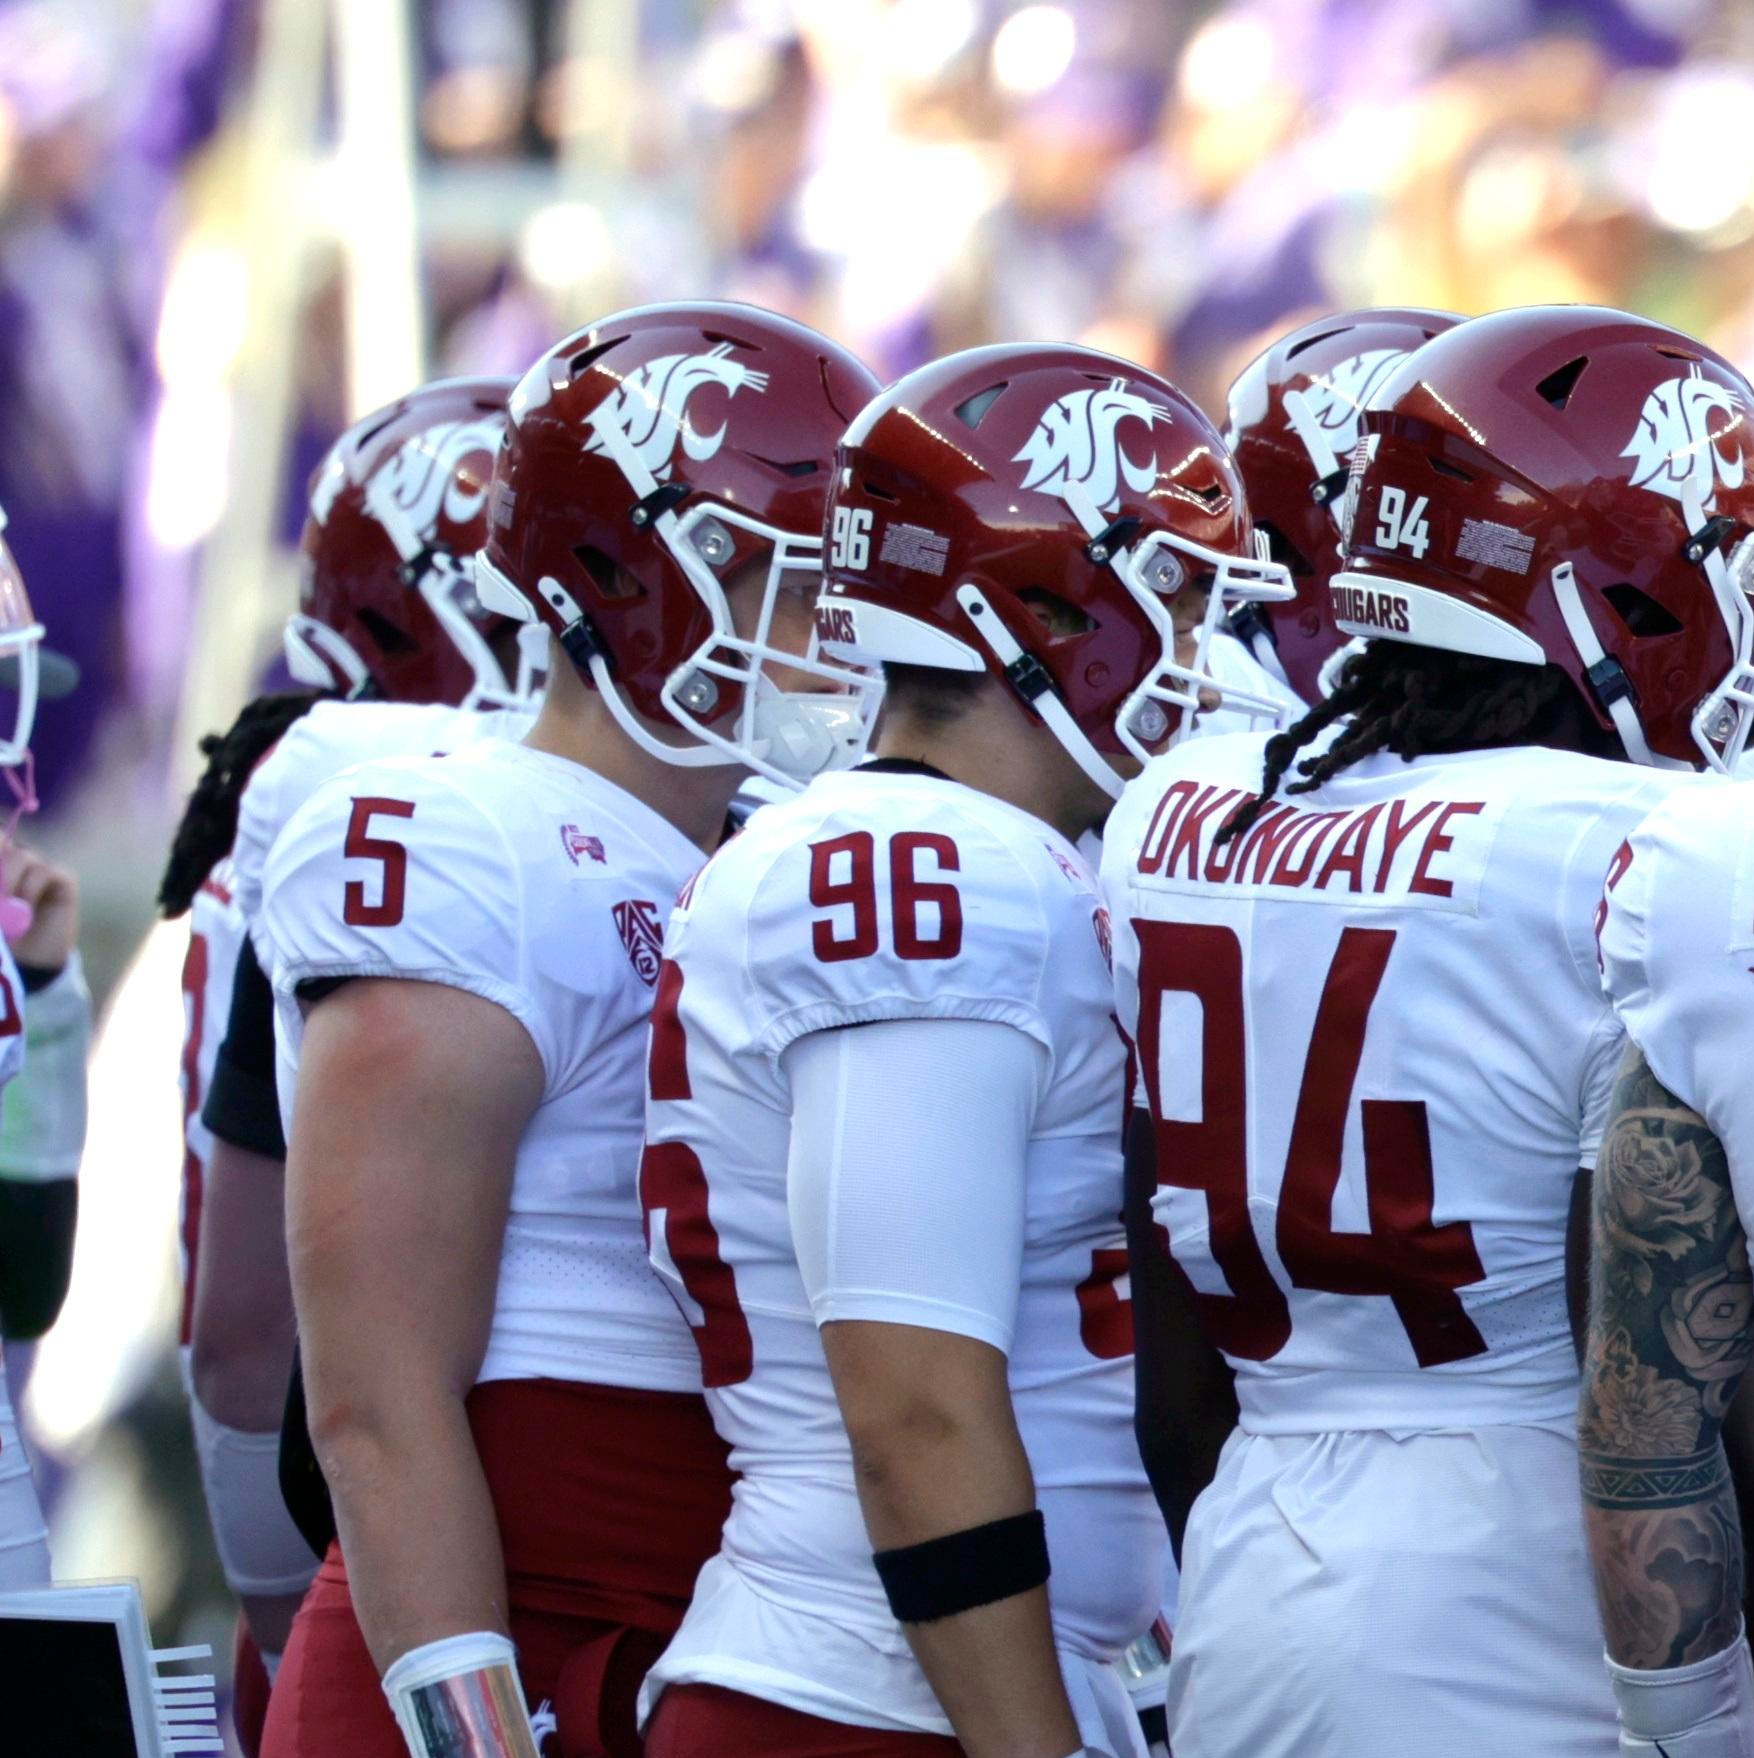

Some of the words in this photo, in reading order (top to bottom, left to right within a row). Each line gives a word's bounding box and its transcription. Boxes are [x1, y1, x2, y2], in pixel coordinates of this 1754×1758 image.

[831, 506, 873, 571] 96
[1375, 485, 1429, 559] 94
[342, 796, 415, 927] 5
[808, 831, 964, 963] 96
[1137, 780, 1487, 898] OKUNDAYE
[1130, 918, 1488, 1368] 94
